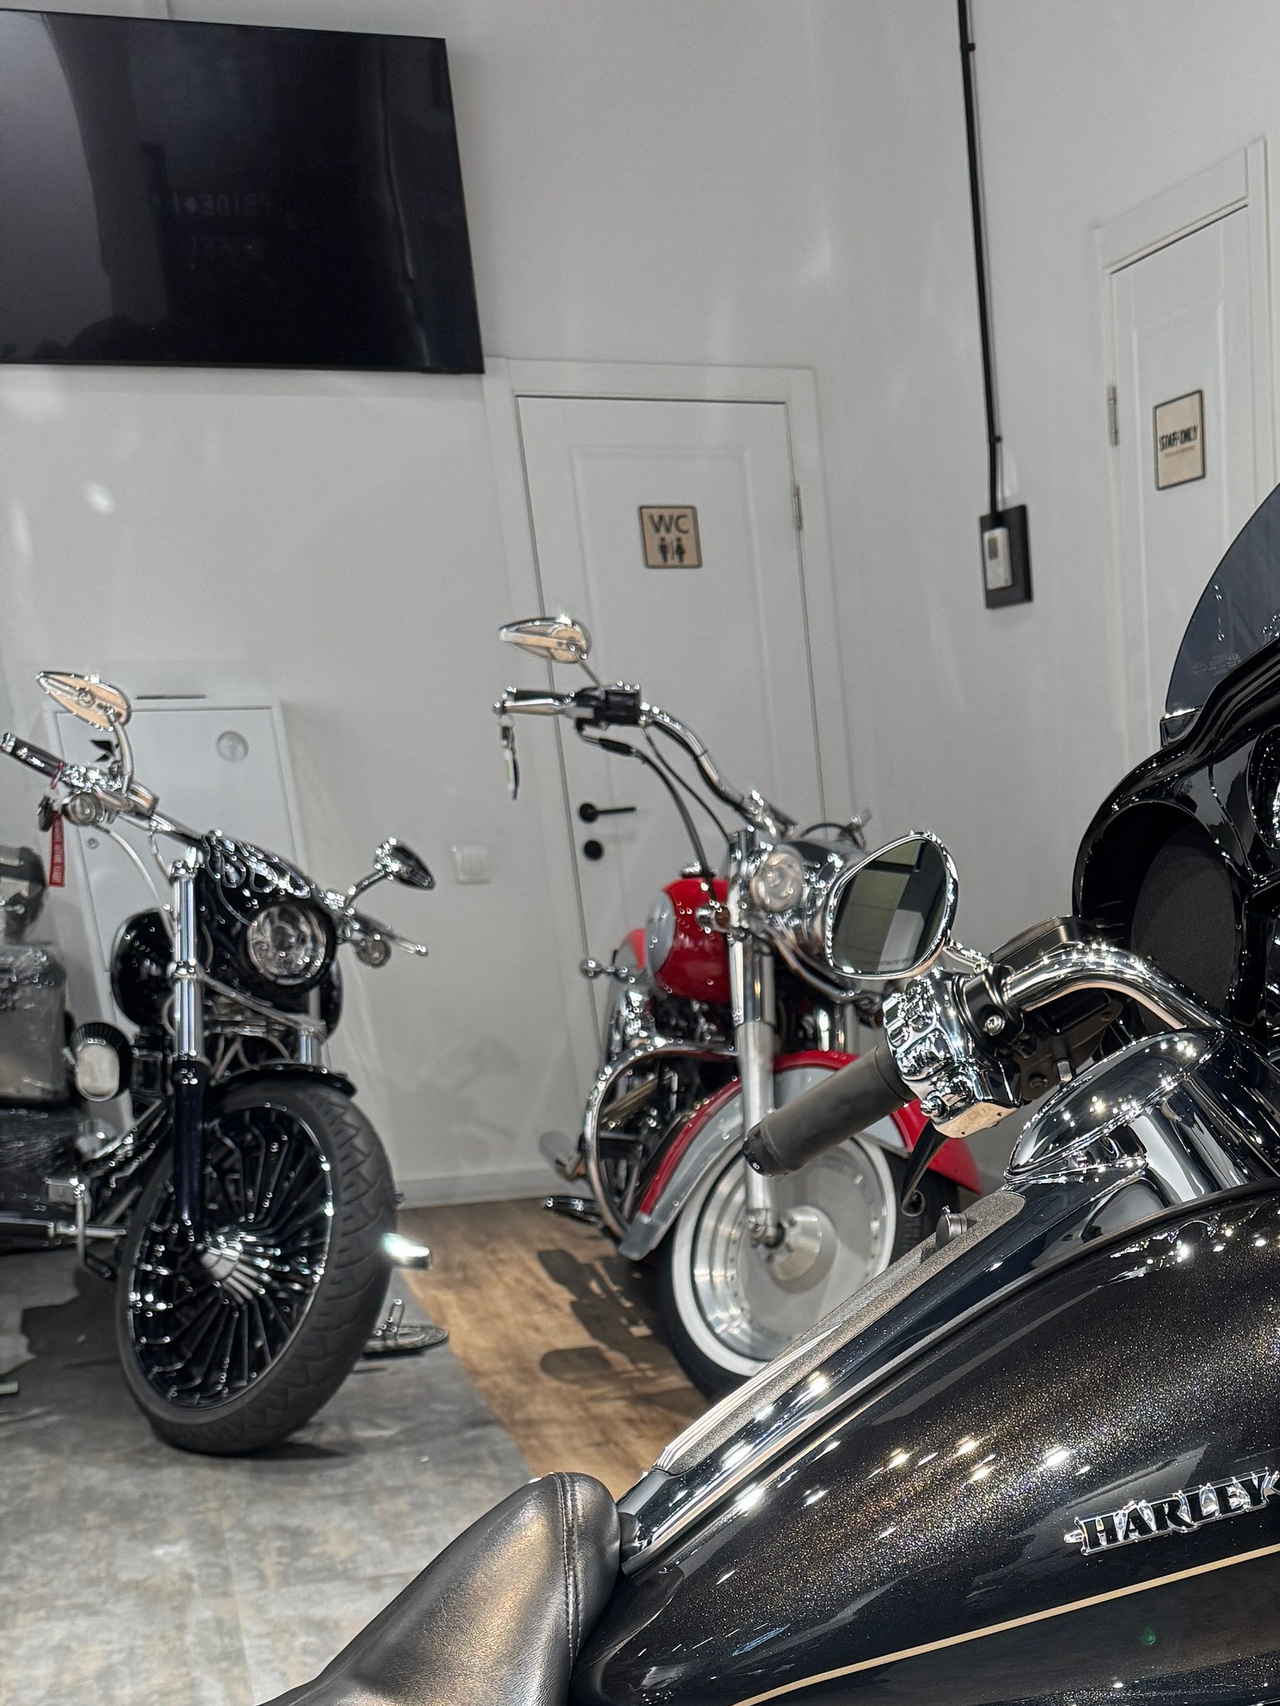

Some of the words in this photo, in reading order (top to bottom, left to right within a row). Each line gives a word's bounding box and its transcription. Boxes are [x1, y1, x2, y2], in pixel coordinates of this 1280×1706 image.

[1159, 431, 1180, 451] STAFF
[1180, 424, 1199, 445] ONLY
[648, 514, 689, 534] WC
